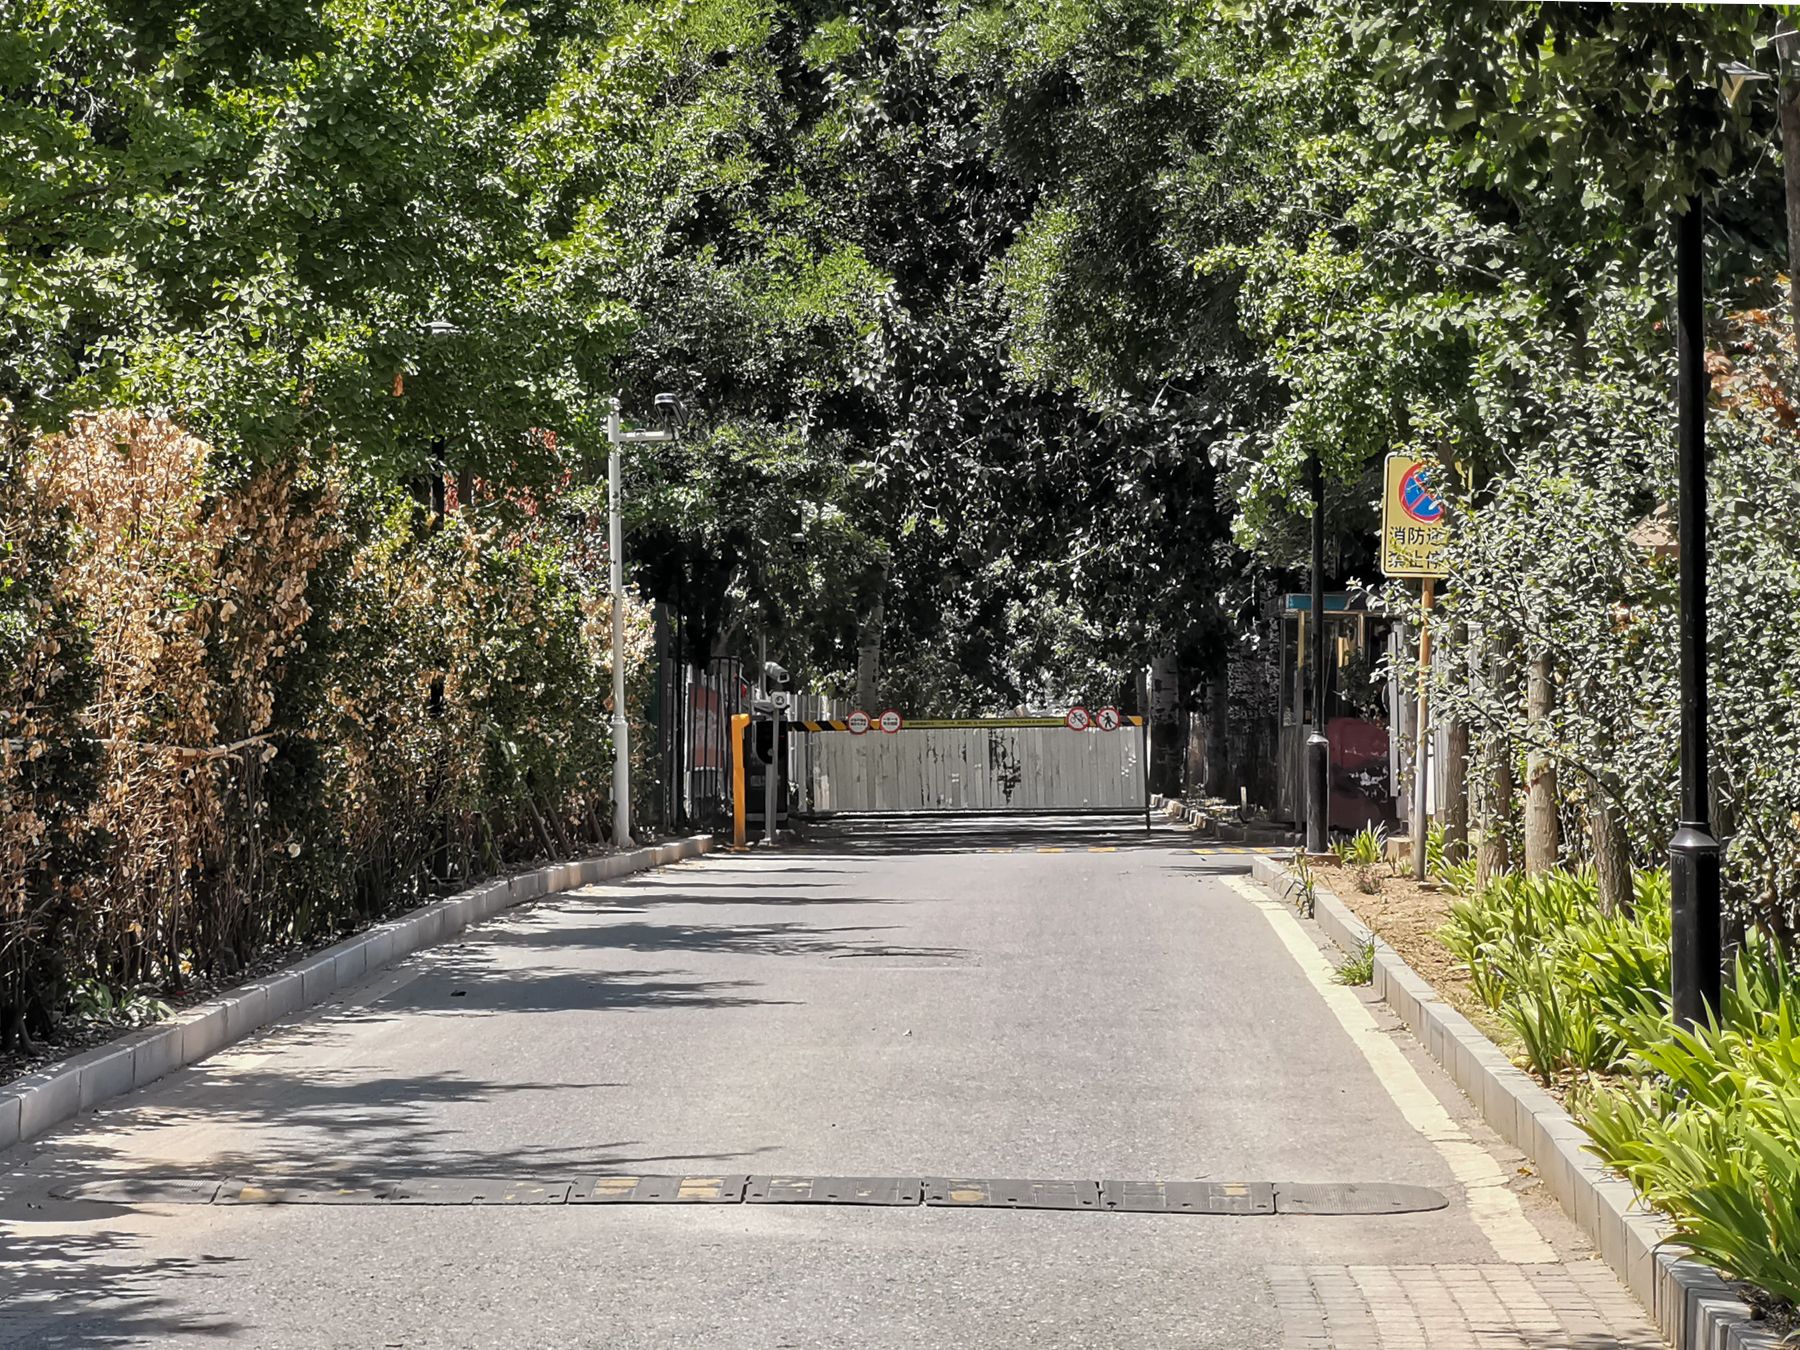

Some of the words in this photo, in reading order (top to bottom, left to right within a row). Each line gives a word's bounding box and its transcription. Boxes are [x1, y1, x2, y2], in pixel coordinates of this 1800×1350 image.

[1389, 526, 1447, 546] 消防通
[1388, 550, 1447, 569] 禁止停
